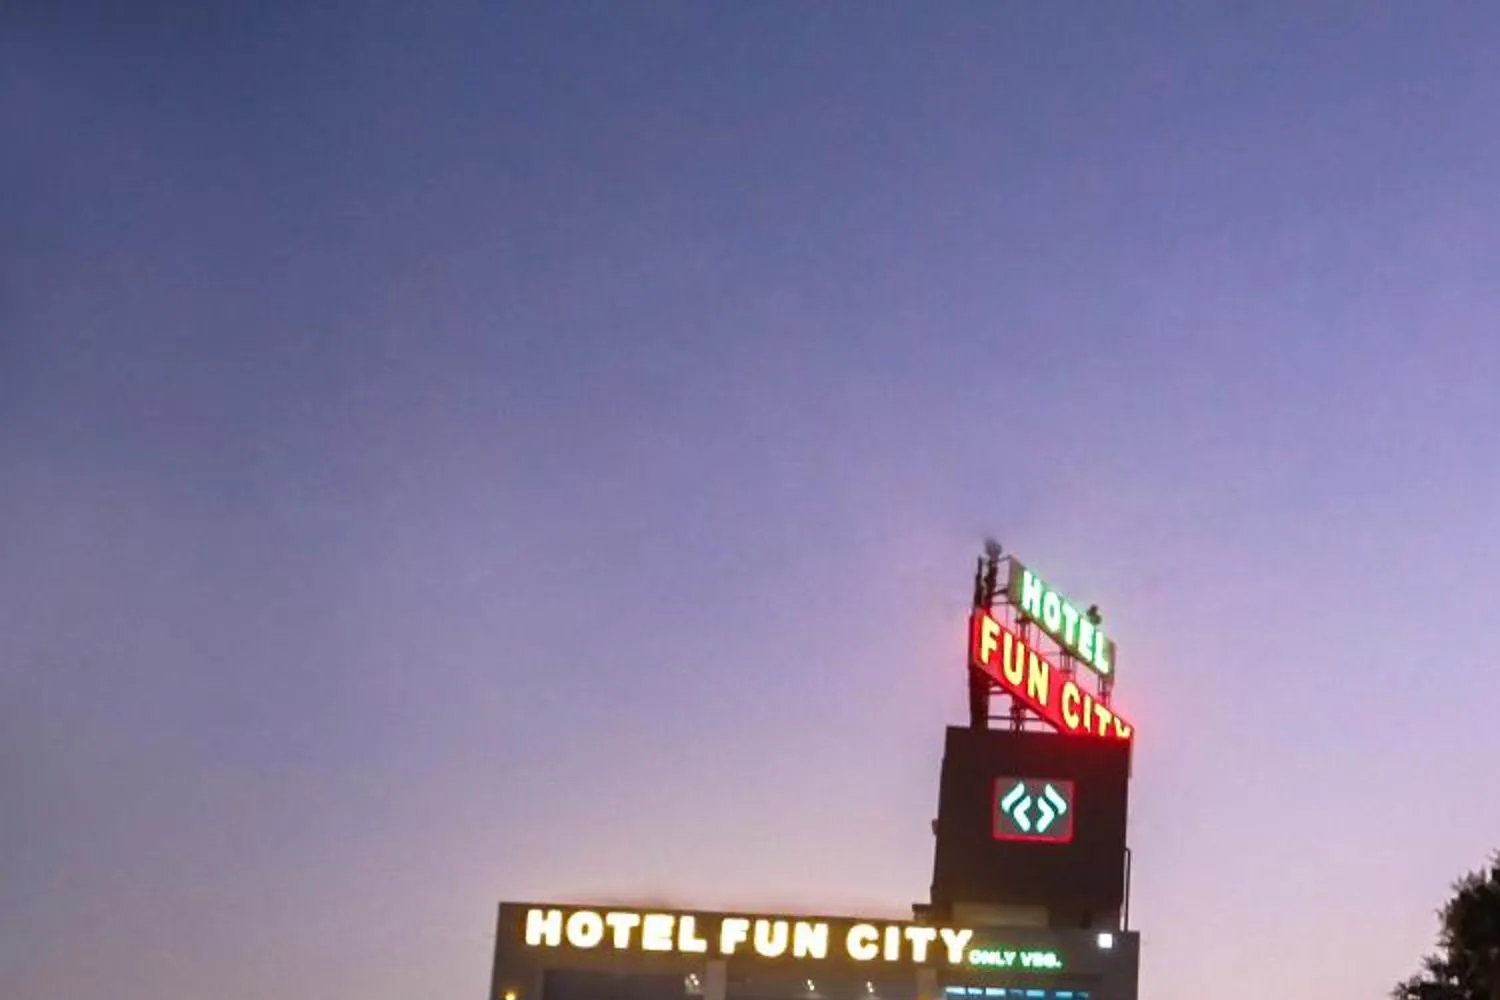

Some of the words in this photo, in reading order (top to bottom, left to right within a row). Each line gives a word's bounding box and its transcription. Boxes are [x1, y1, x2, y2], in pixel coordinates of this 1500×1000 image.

[1020, 568, 1110, 675] HOTEL
[980, 614, 1049, 706] FUN
[525, 909, 708, 953] HOTEL
[720, 917, 829, 959] FUN
[846, 923, 973, 964] CITY
[969, 949, 1016, 968] ONLY
